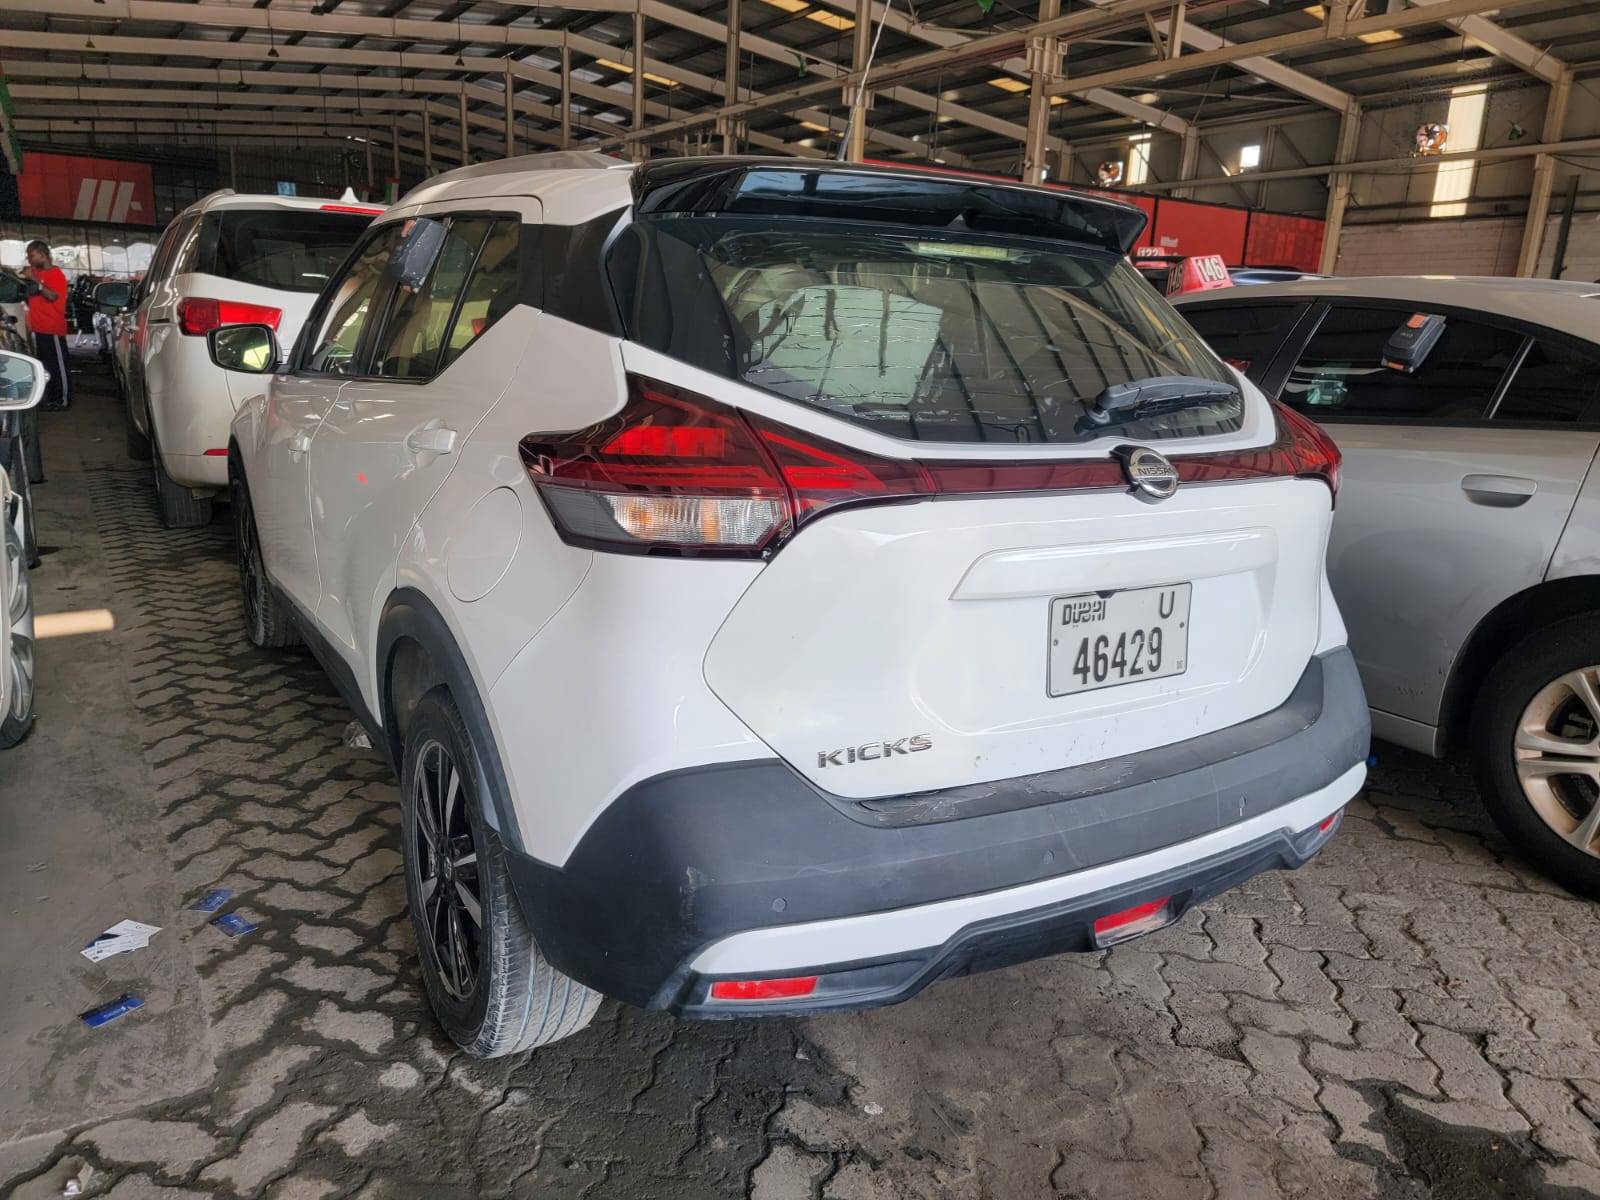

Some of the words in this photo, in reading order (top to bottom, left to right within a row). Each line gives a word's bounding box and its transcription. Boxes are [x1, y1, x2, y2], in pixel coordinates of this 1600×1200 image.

[1197, 257, 1225, 282] 146
[1061, 599, 1106, 625] DUBAI
[1159, 591, 1175, 619] U
[1072, 627, 1163, 685] 46429
[818, 733, 933, 769] KICKS
